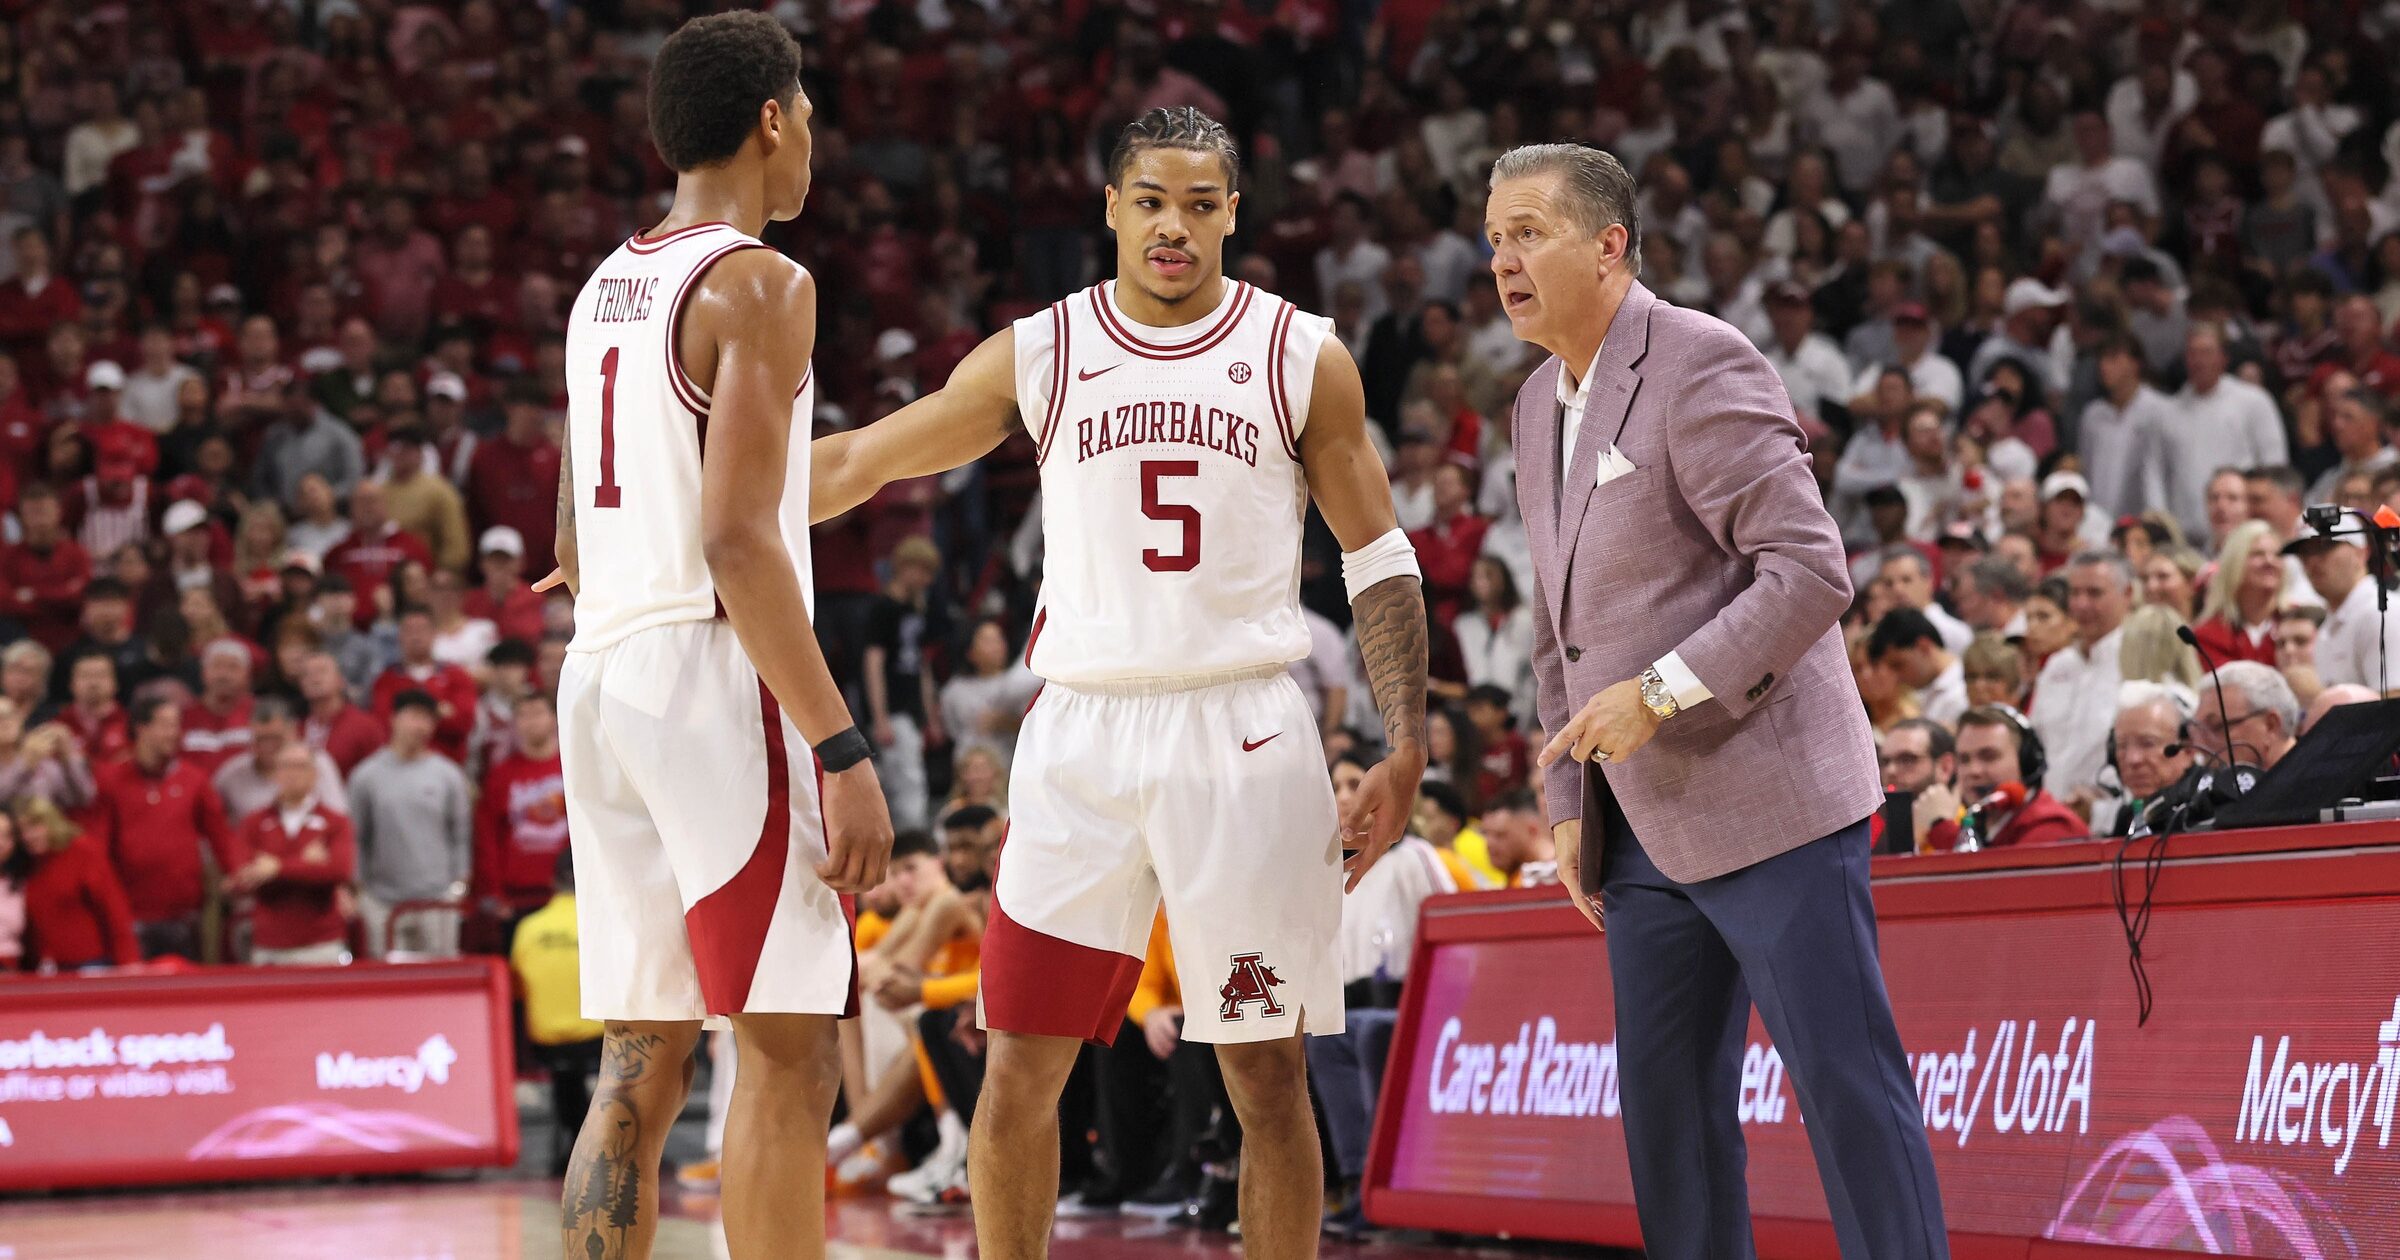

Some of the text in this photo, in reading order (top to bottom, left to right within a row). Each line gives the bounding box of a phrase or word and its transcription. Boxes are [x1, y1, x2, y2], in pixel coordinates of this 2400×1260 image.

[593, 277, 659, 323] THOMAS
[1230, 363, 1251, 383] SEC
[593, 346, 621, 509] 1
[1077, 401, 1260, 468] RAZORBACKS
[1140, 460, 1201, 572] 5
[118, 1022, 235, 1071] speed.
[315, 1051, 426, 1094] Mercy
[1428, 1015, 1496, 1115] Care
[1489, 1022, 1532, 1116] at
[1906, 1015, 2097, 1149] net/UofA
[2234, 1034, 2379, 1177] Mercy
